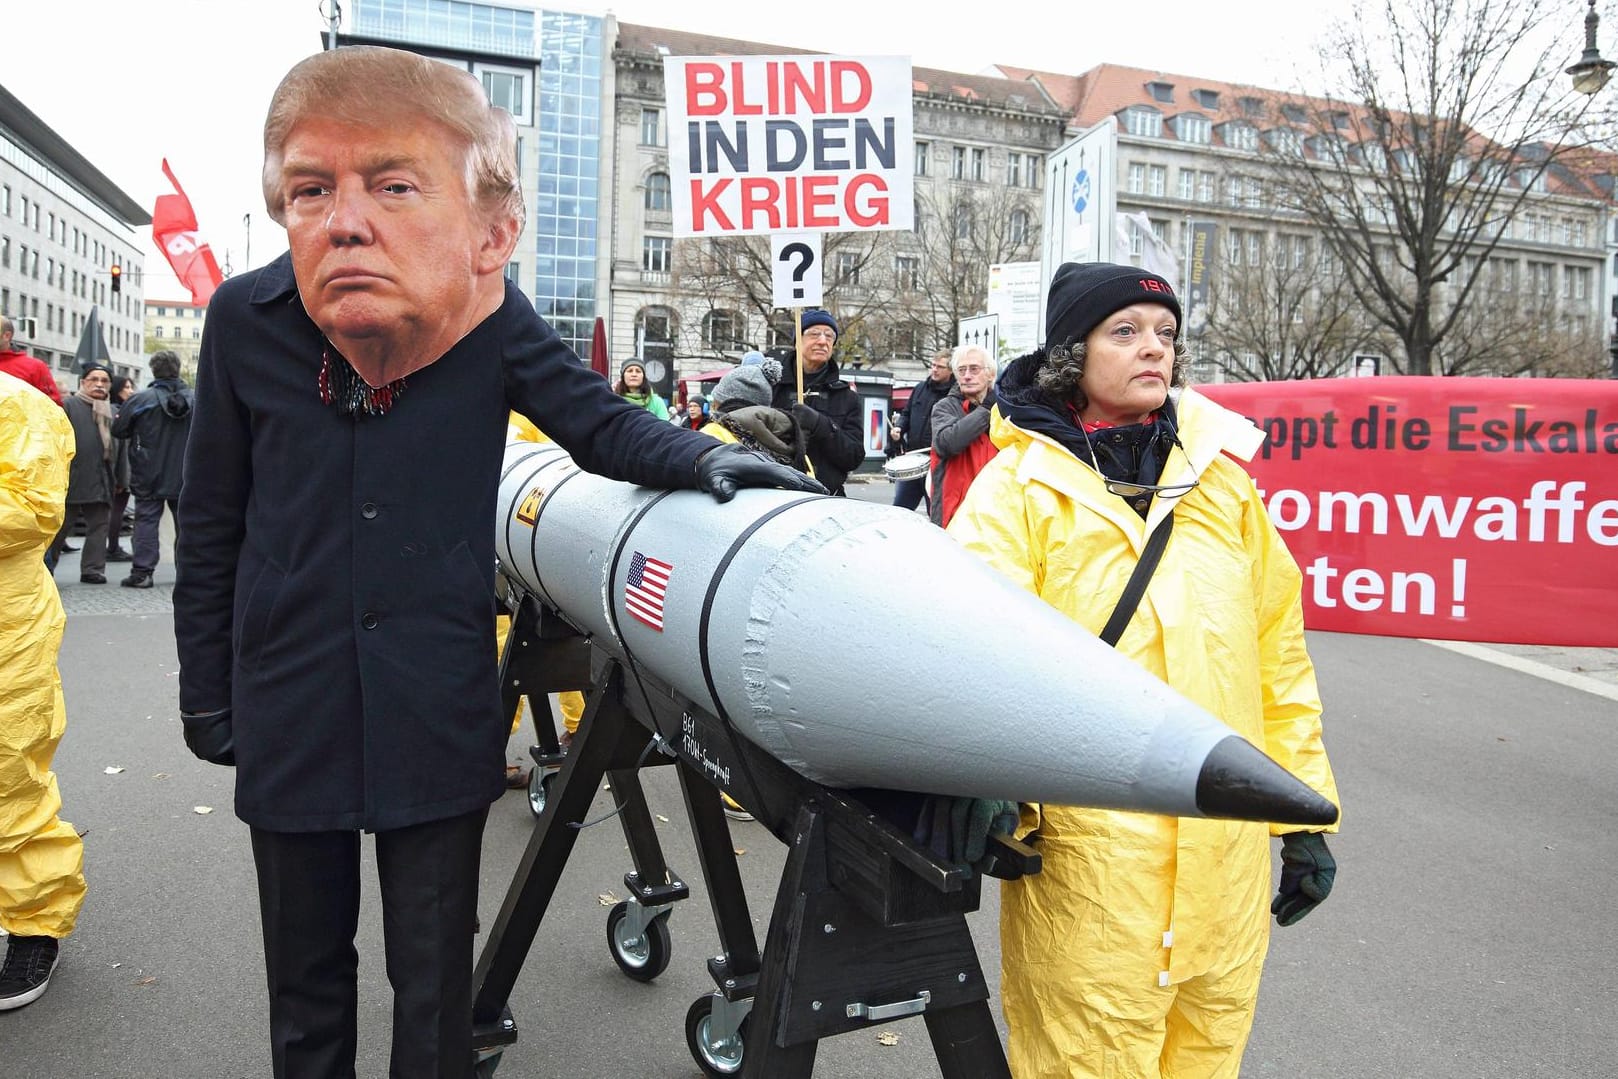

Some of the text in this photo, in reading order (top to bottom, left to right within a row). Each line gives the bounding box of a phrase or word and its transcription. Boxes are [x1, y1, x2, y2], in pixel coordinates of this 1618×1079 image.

[684, 60, 873, 116] BLIND
[687, 116, 896, 173] IN DEN
[690, 173, 889, 232] KRIEG
[779, 242, 815, 299] ?
[1245, 408, 1340, 459] ppt
[1351, 405, 1431, 450] die
[1251, 477, 1618, 546] omwaffe
[682, 711, 695, 737] B61
